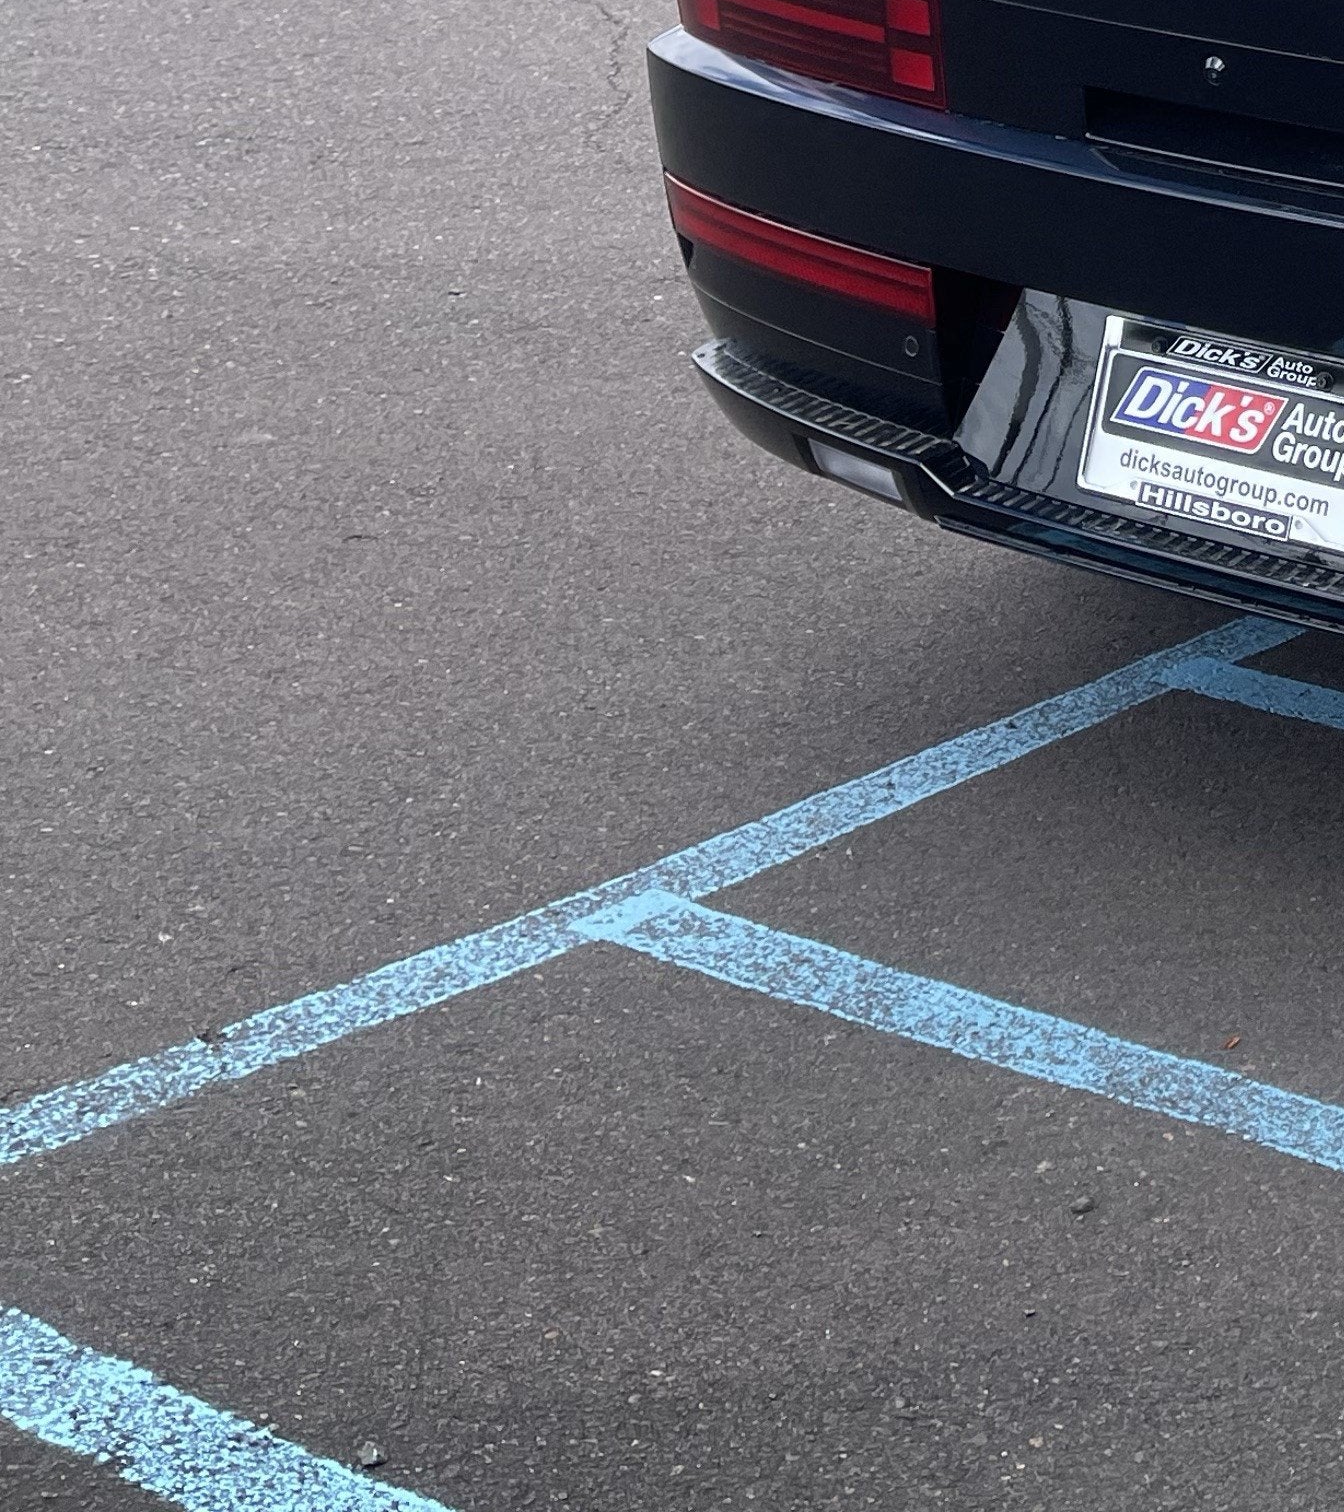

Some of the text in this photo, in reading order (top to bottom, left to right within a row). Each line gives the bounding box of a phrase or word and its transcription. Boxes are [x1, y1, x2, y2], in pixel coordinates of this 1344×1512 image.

[1173, 338, 1263, 370] Dick's
[1272, 356, 1314, 375] Auto
[1266, 365, 1318, 388] Group
[1124, 375, 1268, 444] Dick's
[1119, 447, 1330, 517] dicksautogroup.com
[1138, 483, 1287, 536] Hillsboro
